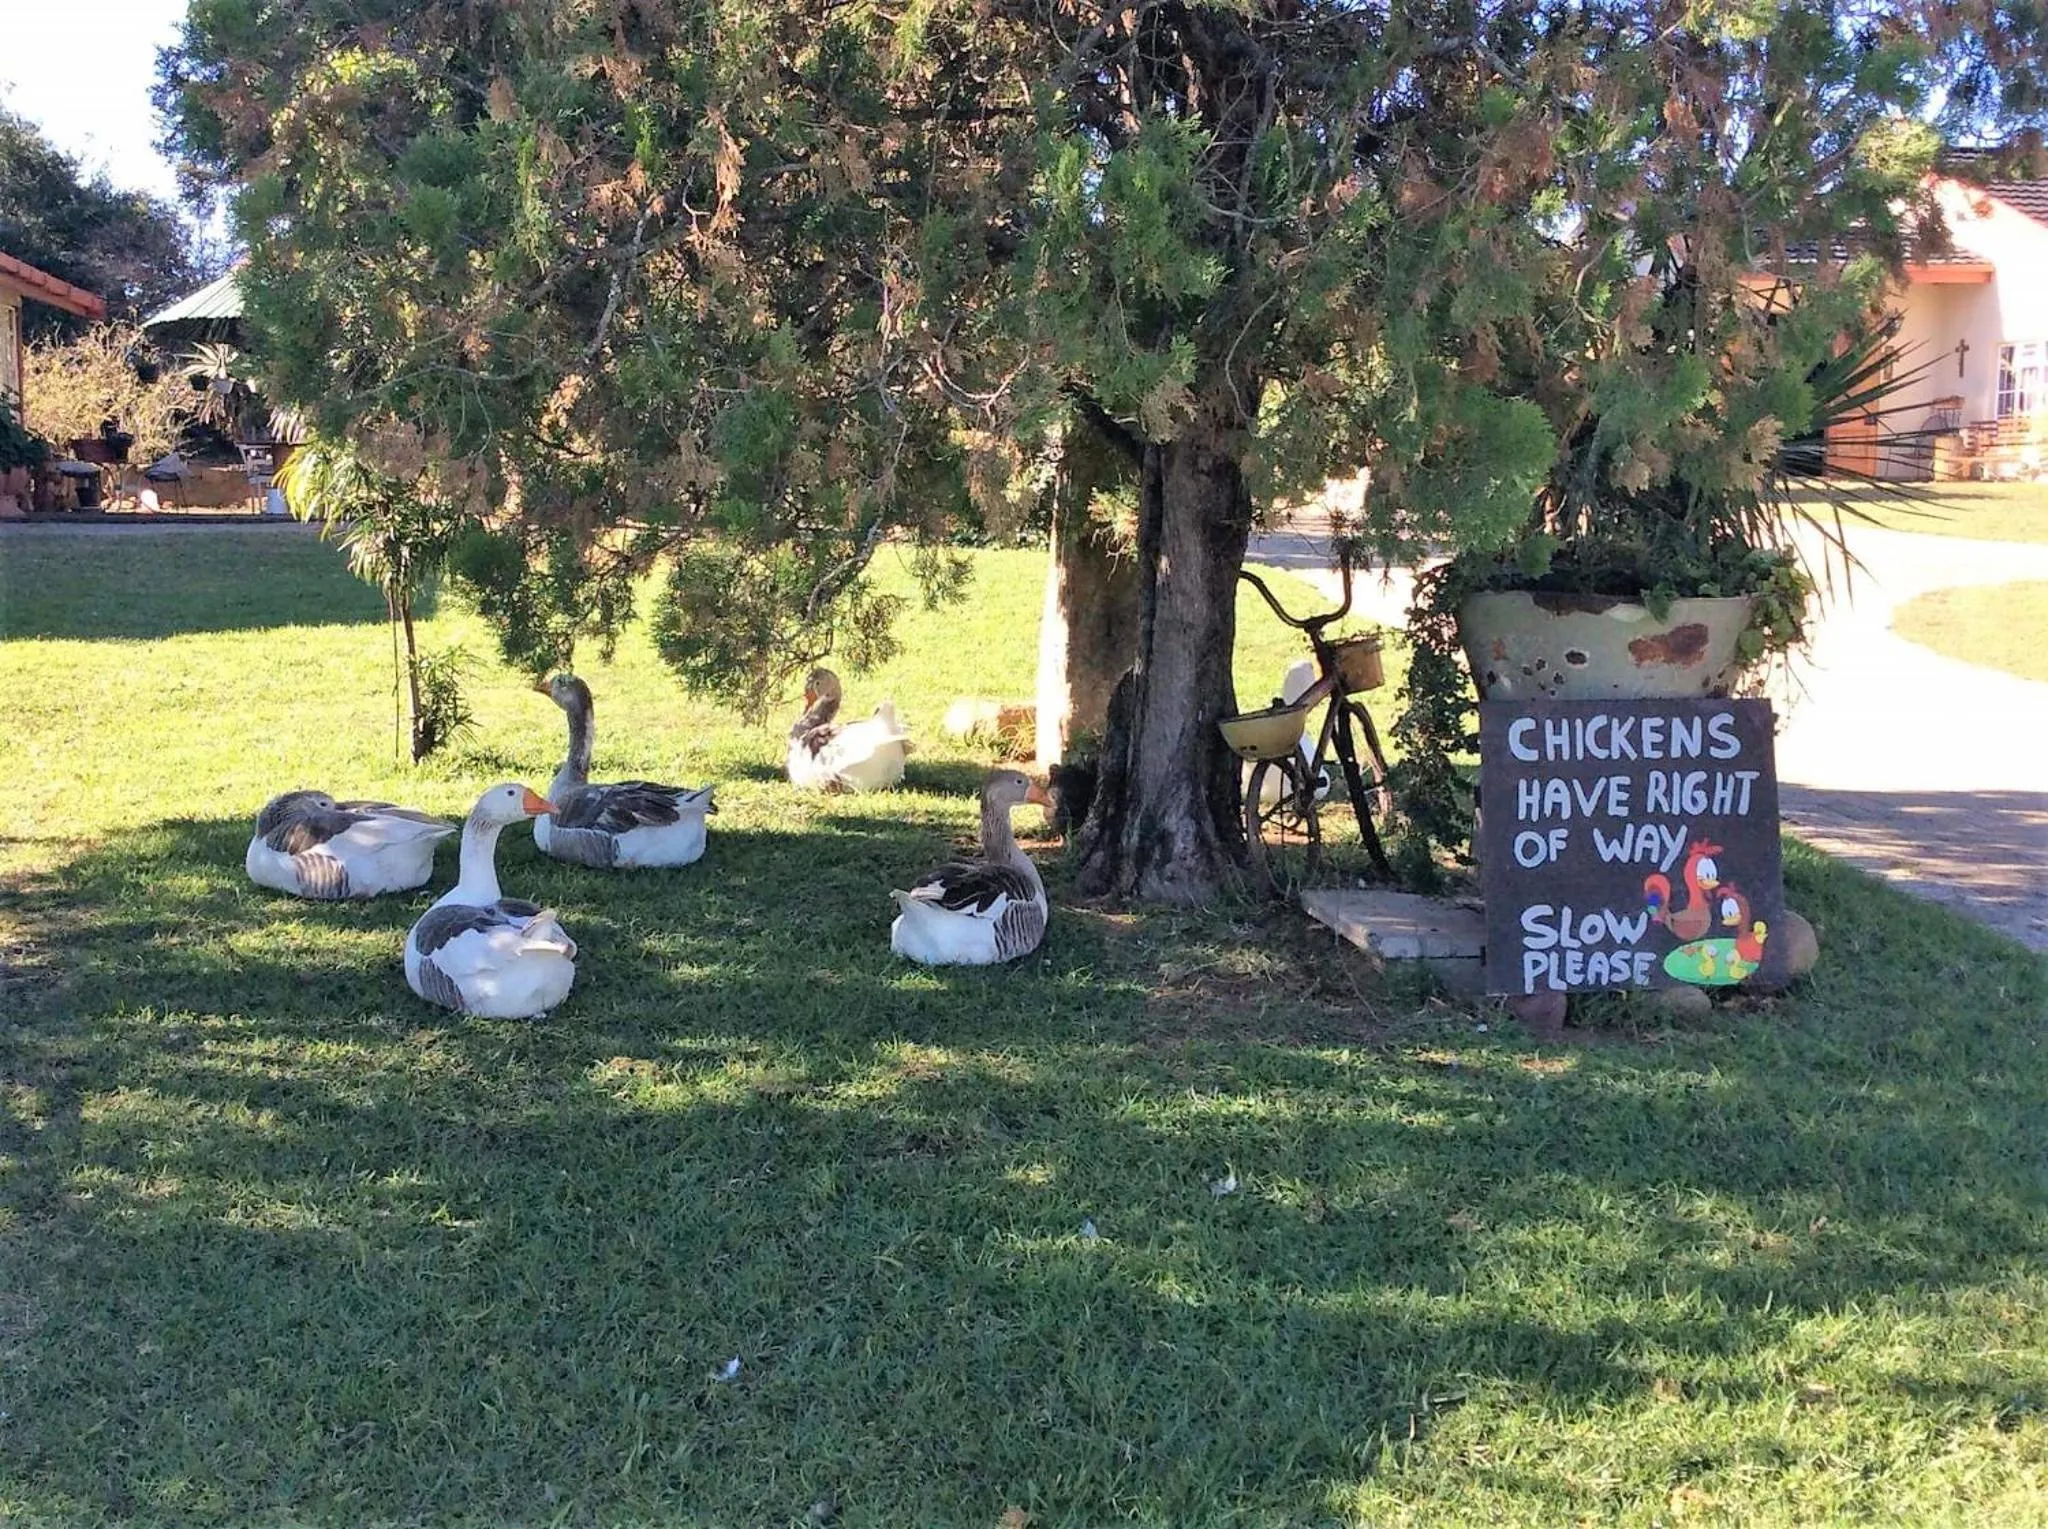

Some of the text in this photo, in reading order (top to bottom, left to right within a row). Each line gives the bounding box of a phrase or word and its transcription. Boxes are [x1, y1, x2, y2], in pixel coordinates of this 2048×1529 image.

[1508, 713, 1741, 761] CHICKENS
[1517, 770, 1760, 822] HAVE RIGHT
[1513, 823, 1688, 873] OF WAY
[1520, 904, 1648, 950] SLOW
[1522, 950, 1657, 994] PLEASE
